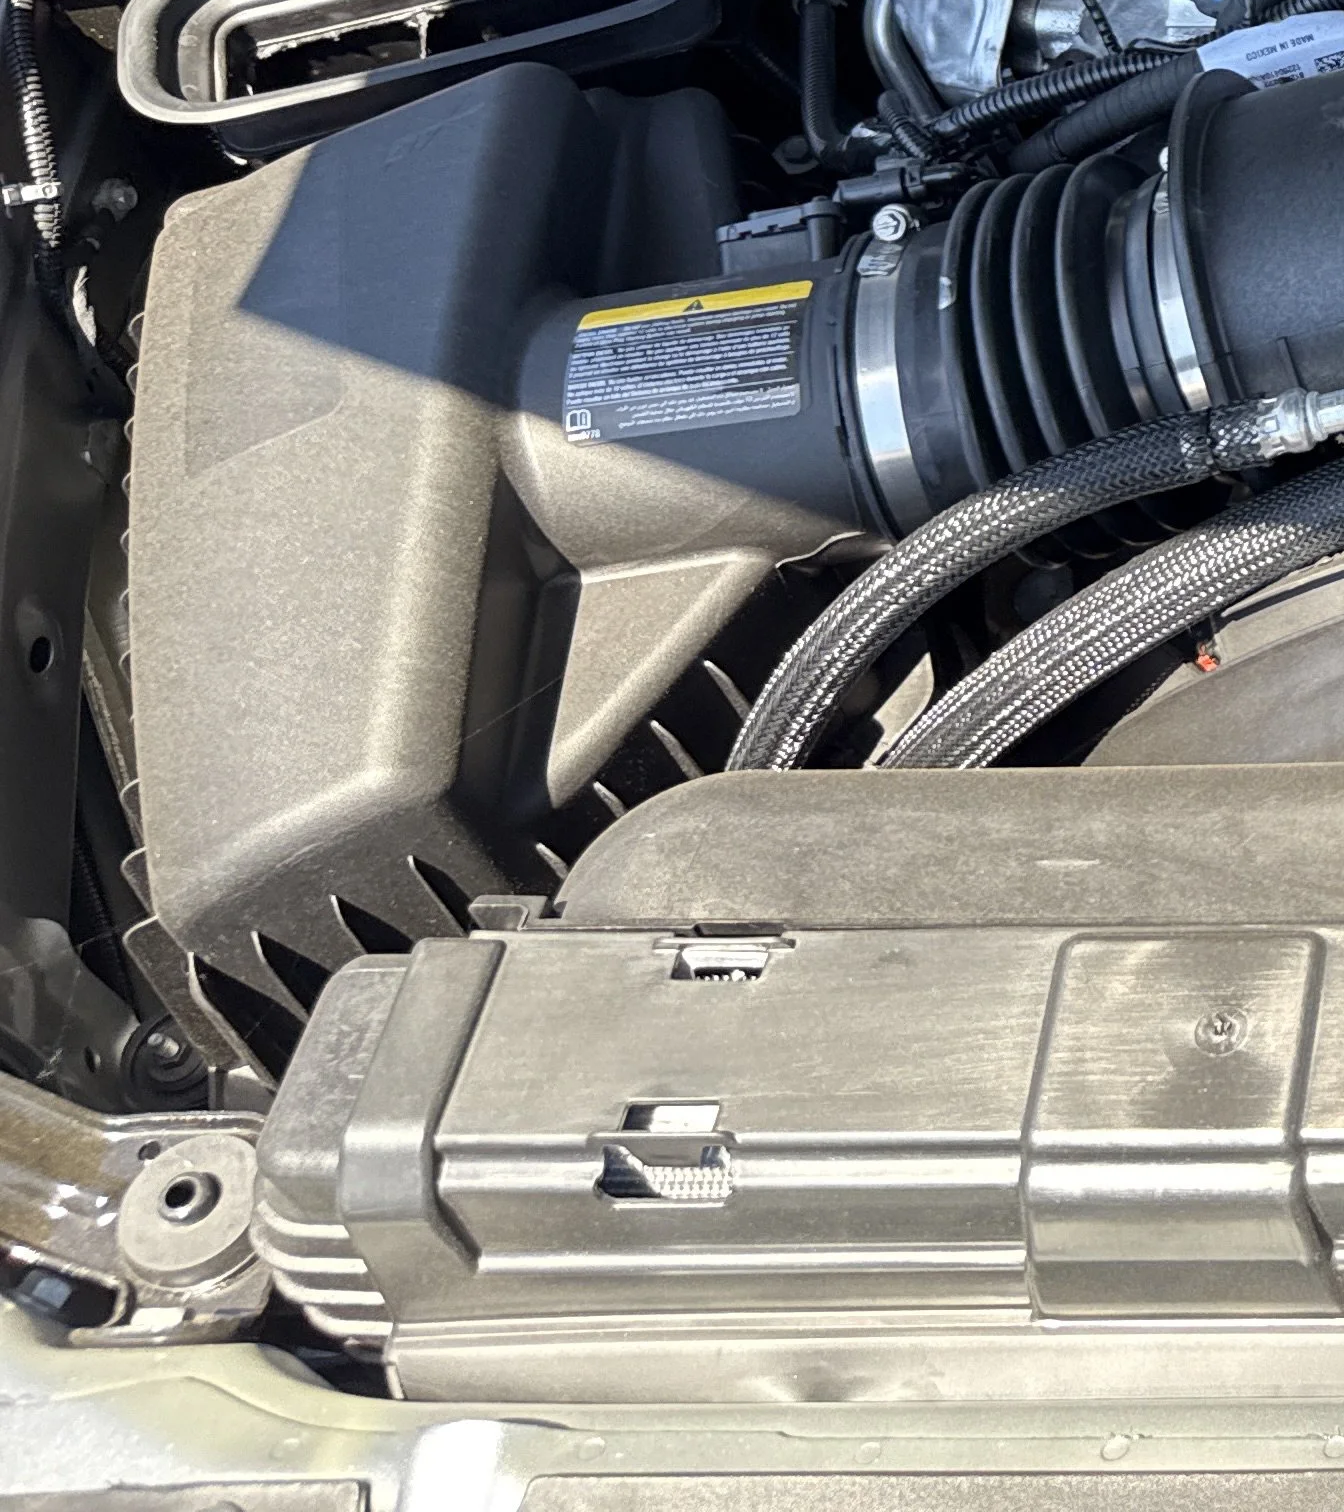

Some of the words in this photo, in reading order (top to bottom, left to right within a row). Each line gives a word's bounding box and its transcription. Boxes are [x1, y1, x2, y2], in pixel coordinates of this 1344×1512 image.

[1279, 41, 1290, 50] IN
[1291, 33, 1315, 48] MADE
[1245, 45, 1278, 62] MEXICO
